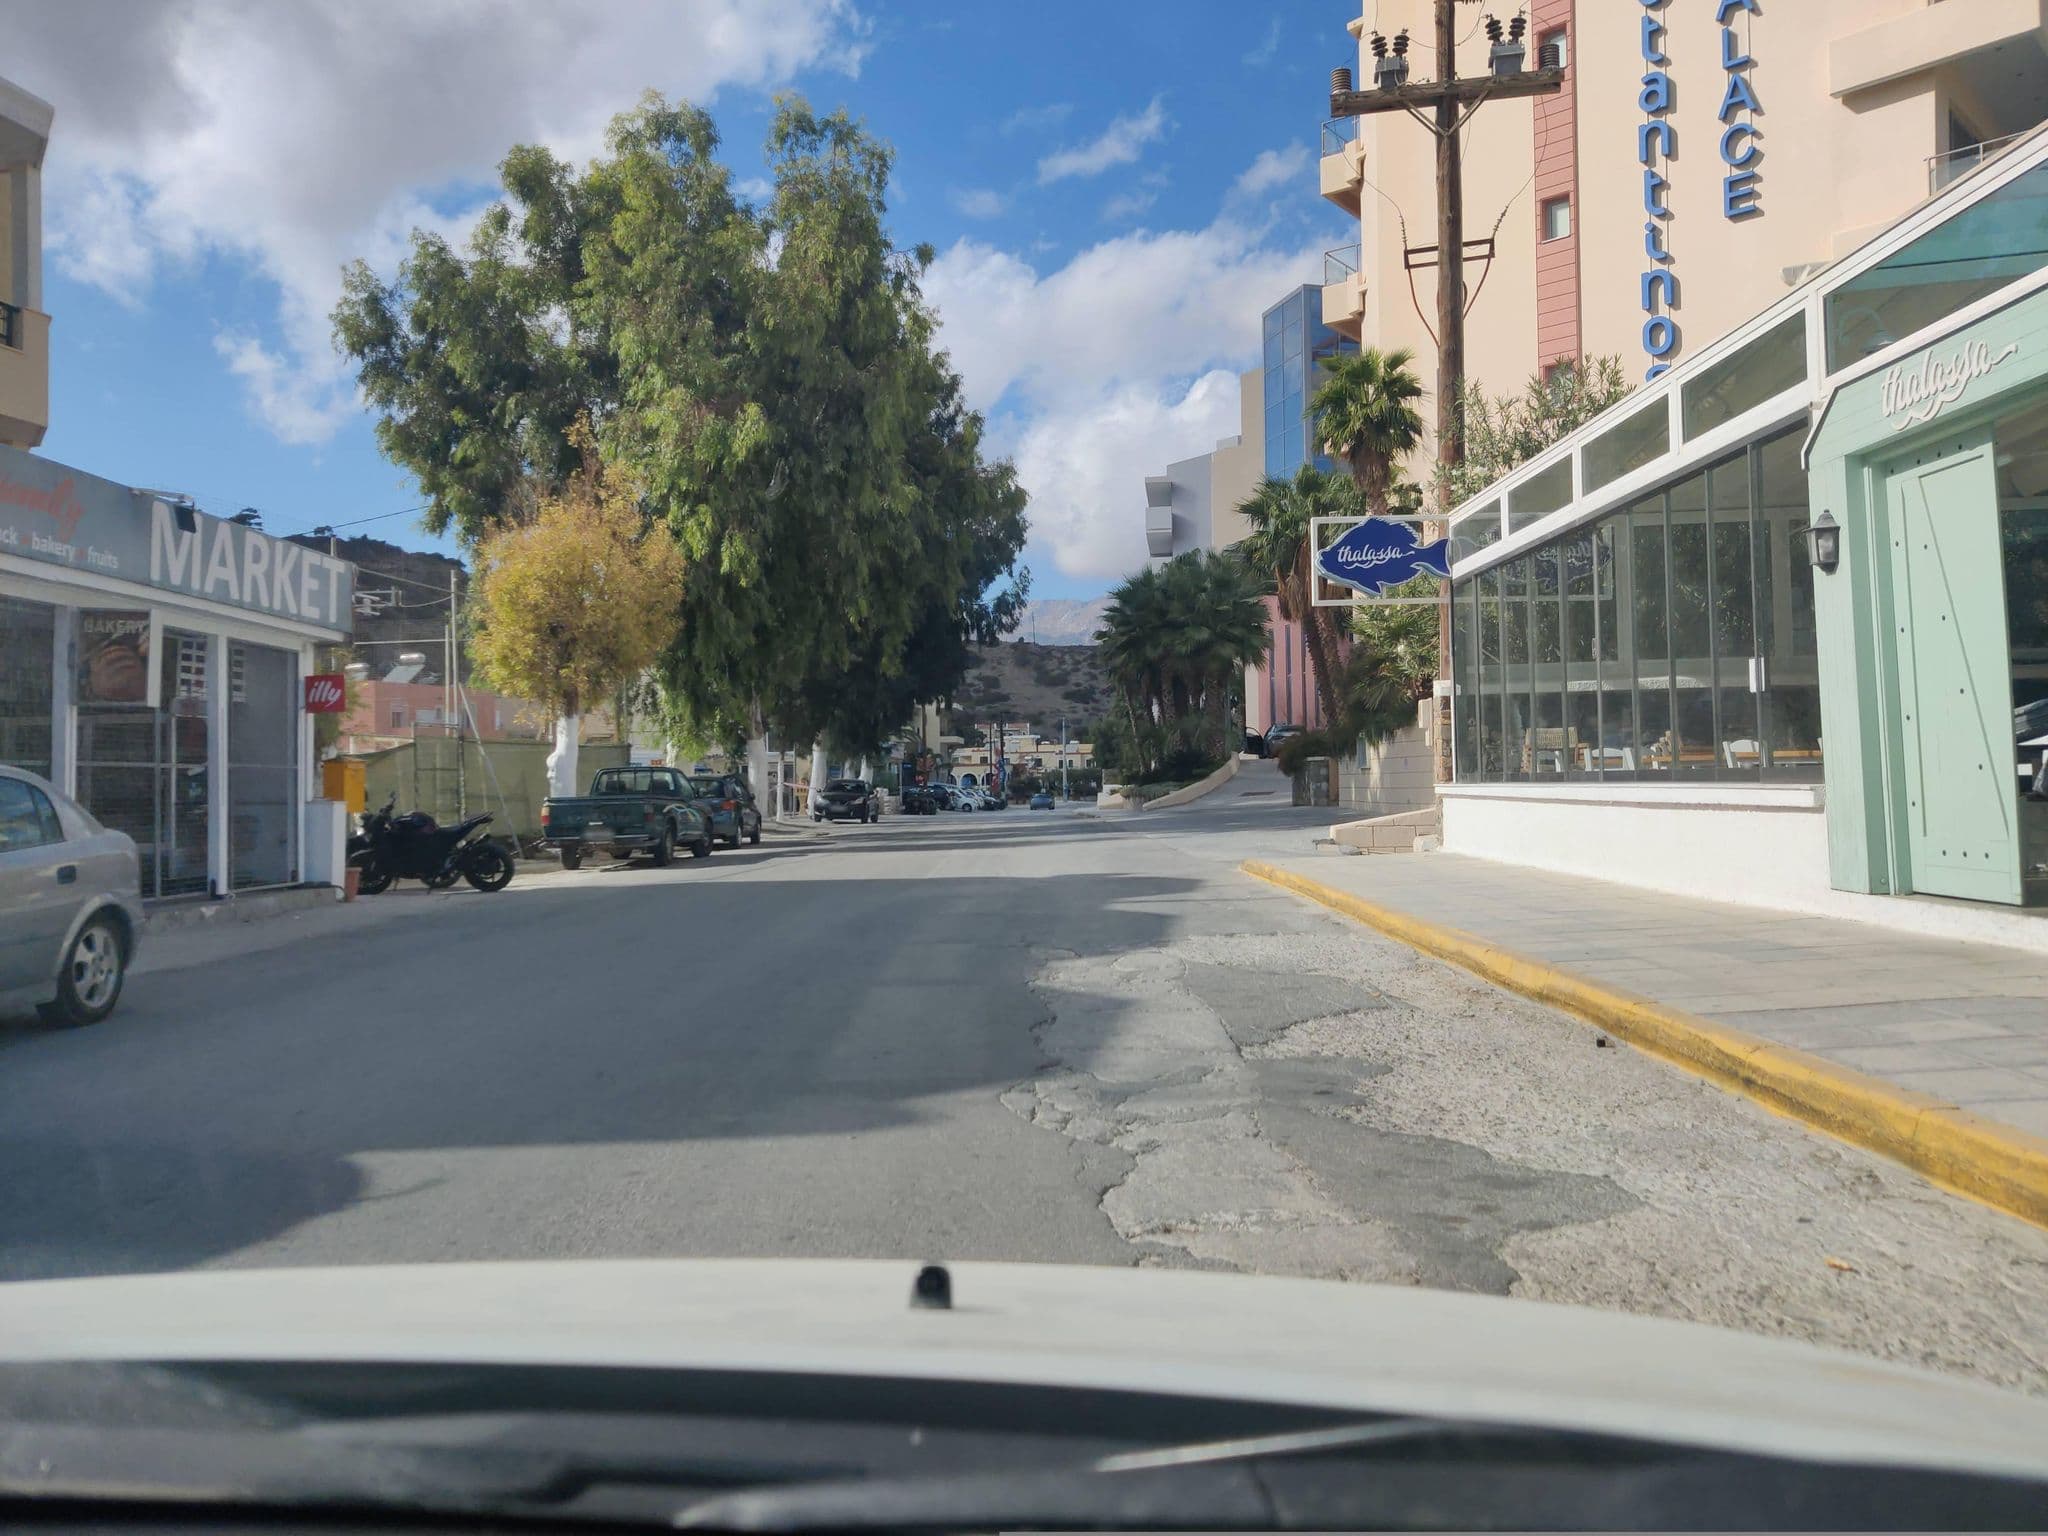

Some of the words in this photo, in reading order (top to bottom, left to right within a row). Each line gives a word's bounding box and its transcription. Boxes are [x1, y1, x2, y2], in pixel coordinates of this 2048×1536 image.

[1638, 0, 1674, 382] tantino
[1881, 338, 2019, 431] thalassa
[31, 531, 75, 563] bakery
[150, 500, 346, 623] MARKET
[1337, 543, 1415, 569] thalassa
[83, 615, 146, 634] BAKERY
[308, 680, 341, 708] illy
